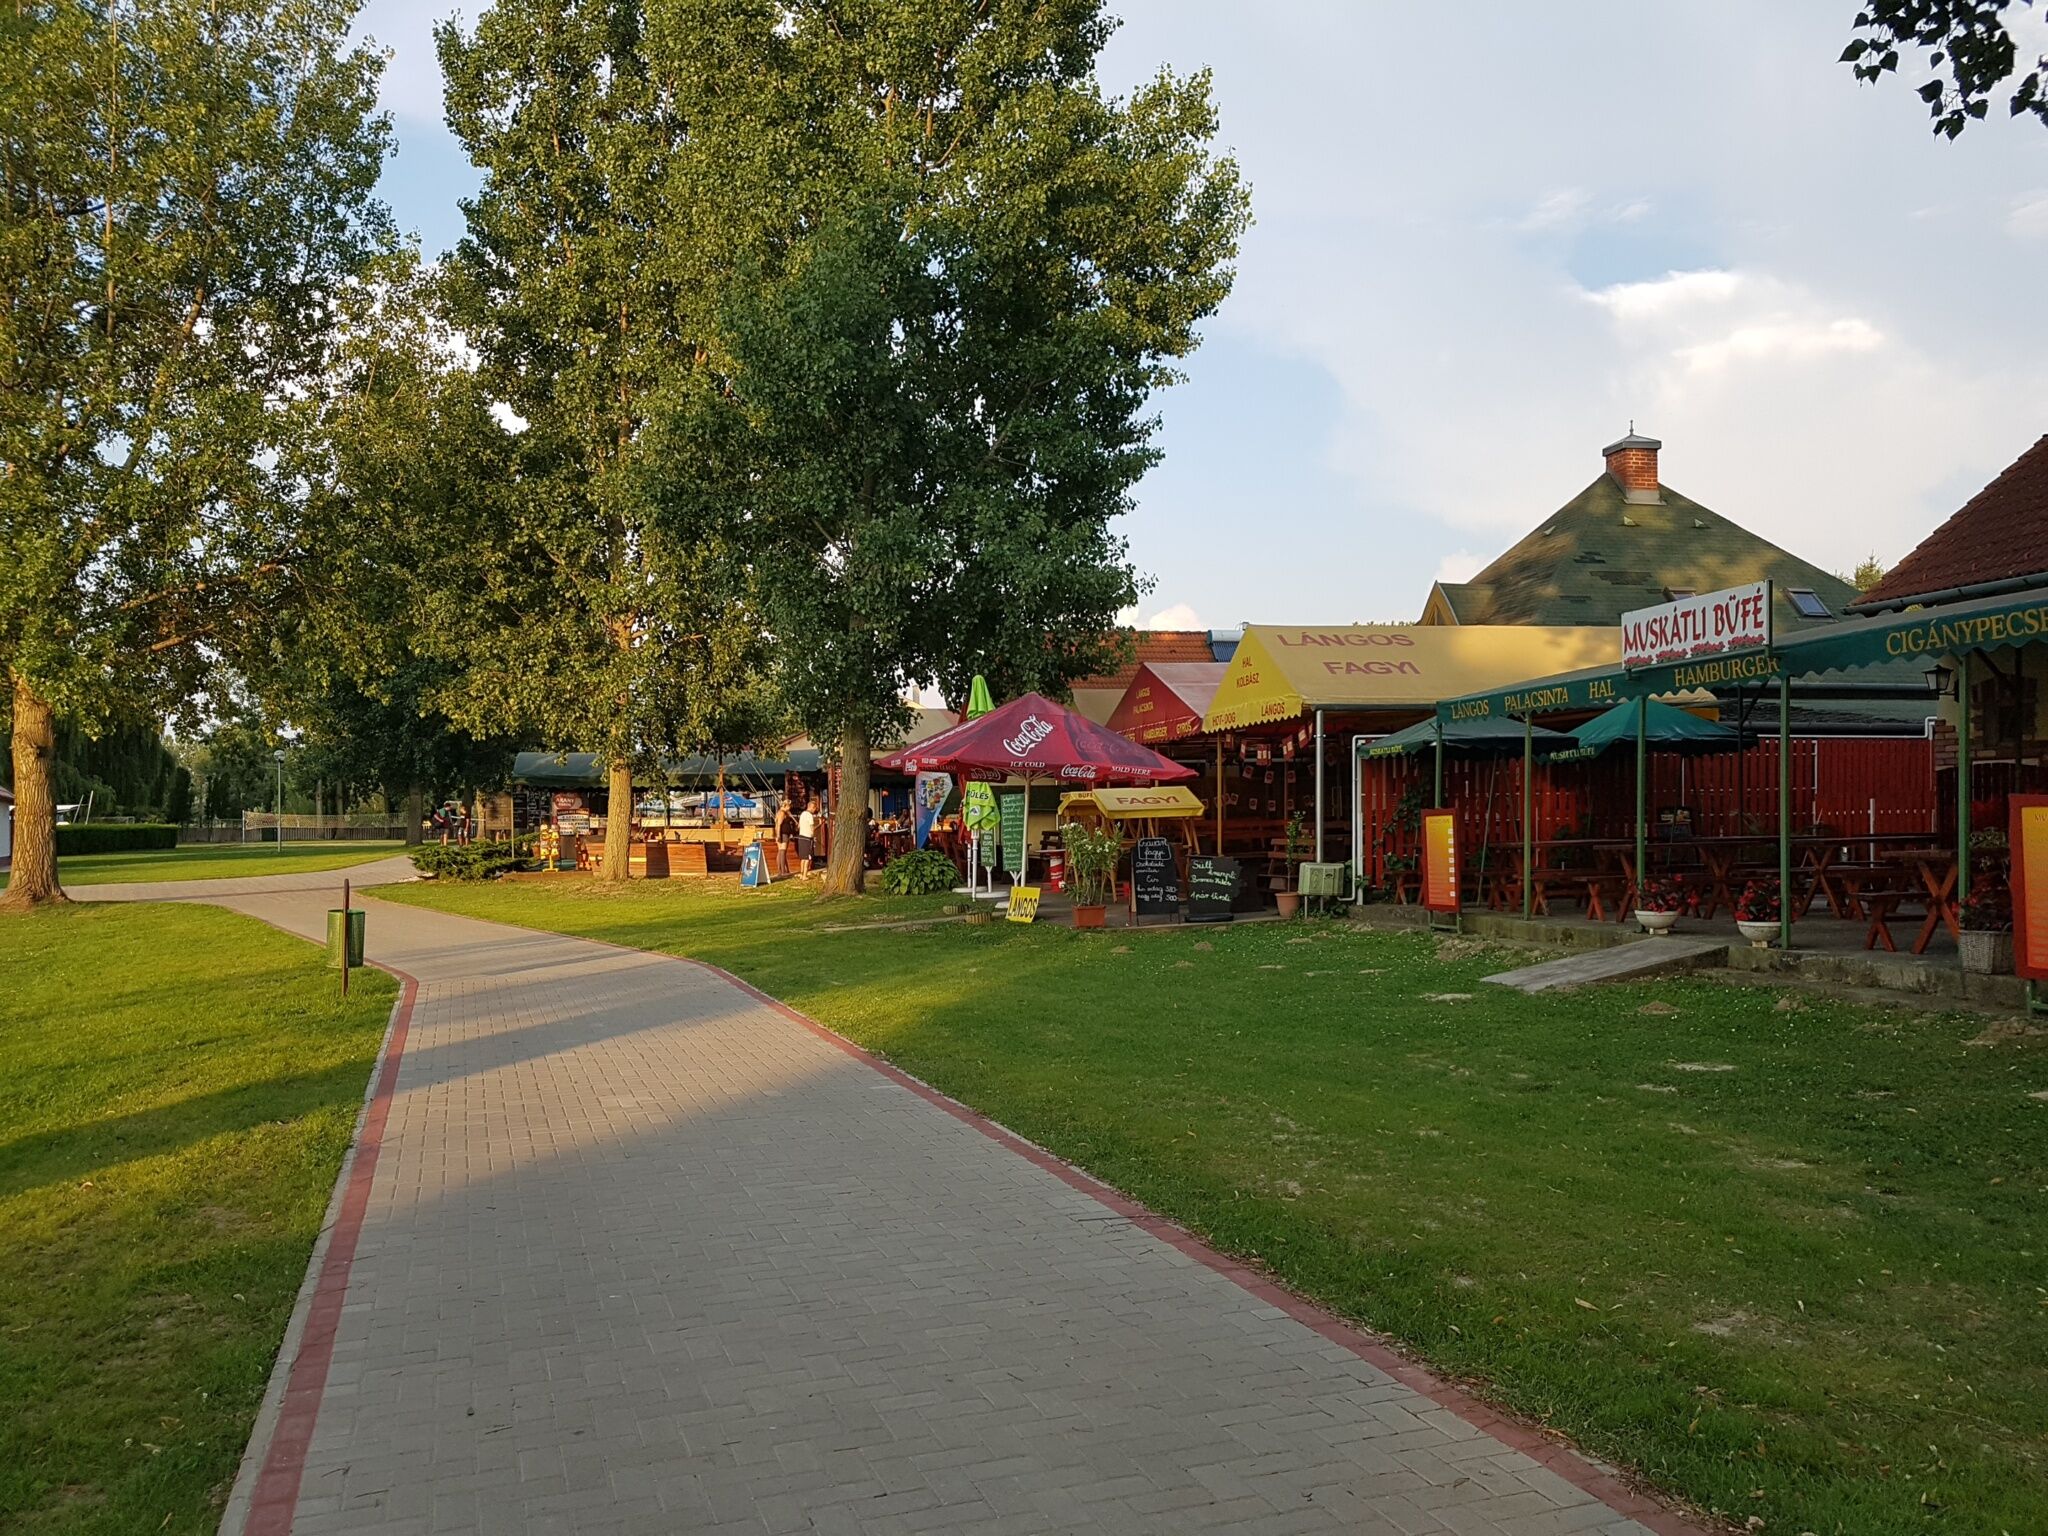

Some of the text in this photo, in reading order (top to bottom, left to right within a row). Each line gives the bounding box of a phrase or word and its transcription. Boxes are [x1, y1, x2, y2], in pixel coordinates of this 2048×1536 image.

[1624, 586, 1764, 654] MUSKÁTLI BÜFÉ
[1277, 631, 1415, 646] LÁNGOS
[1323, 662, 1420, 674] FAGYI
[1451, 654, 1780, 719] LÁNGOS PALACSINTA HAL HAMBURGER
[1111, 766, 1152, 776] SOLD HERE
[1116, 796, 1180, 804] FAGYI
[1008, 891, 1037, 918] LÁNGOS
